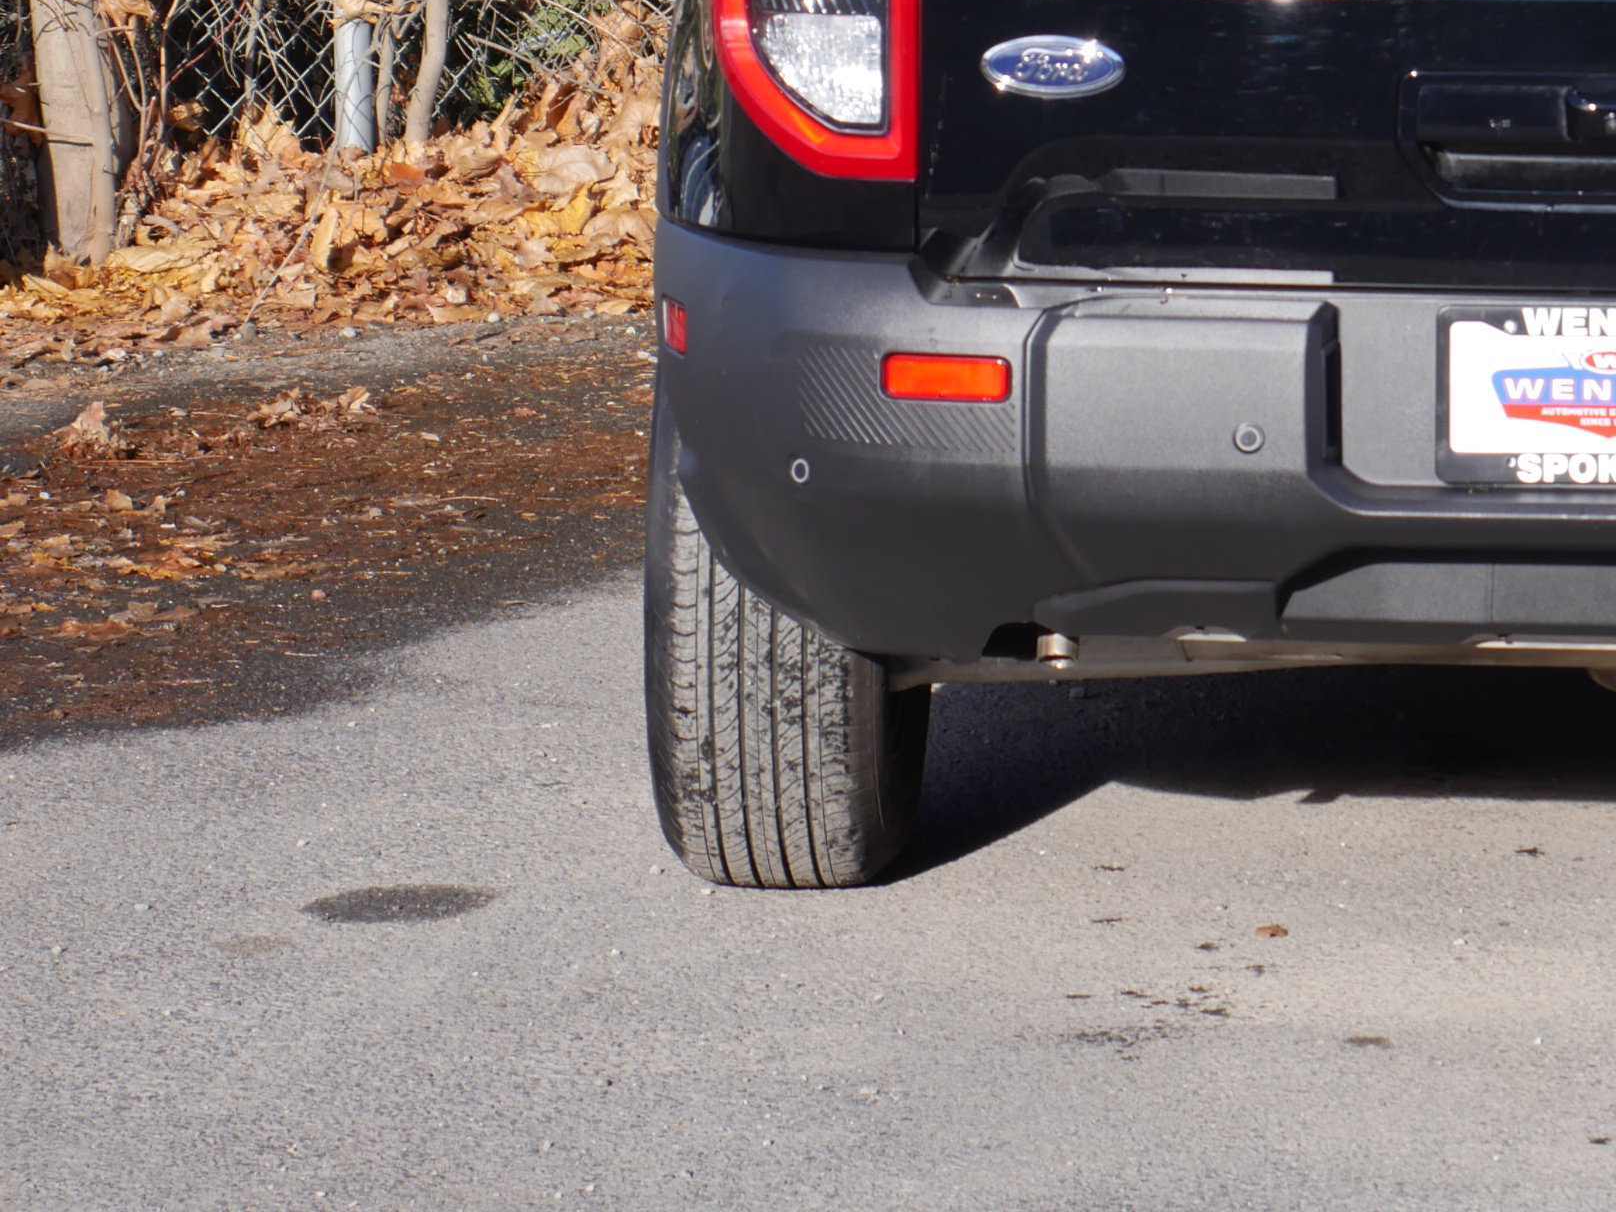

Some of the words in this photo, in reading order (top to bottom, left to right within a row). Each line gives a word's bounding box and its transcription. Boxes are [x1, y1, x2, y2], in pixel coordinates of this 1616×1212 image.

[1014, 48, 1088, 81] Ford
[1541, 407, 1607, 417] AUTOMOTIVE
[1580, 417, 1611, 426] SINCE
